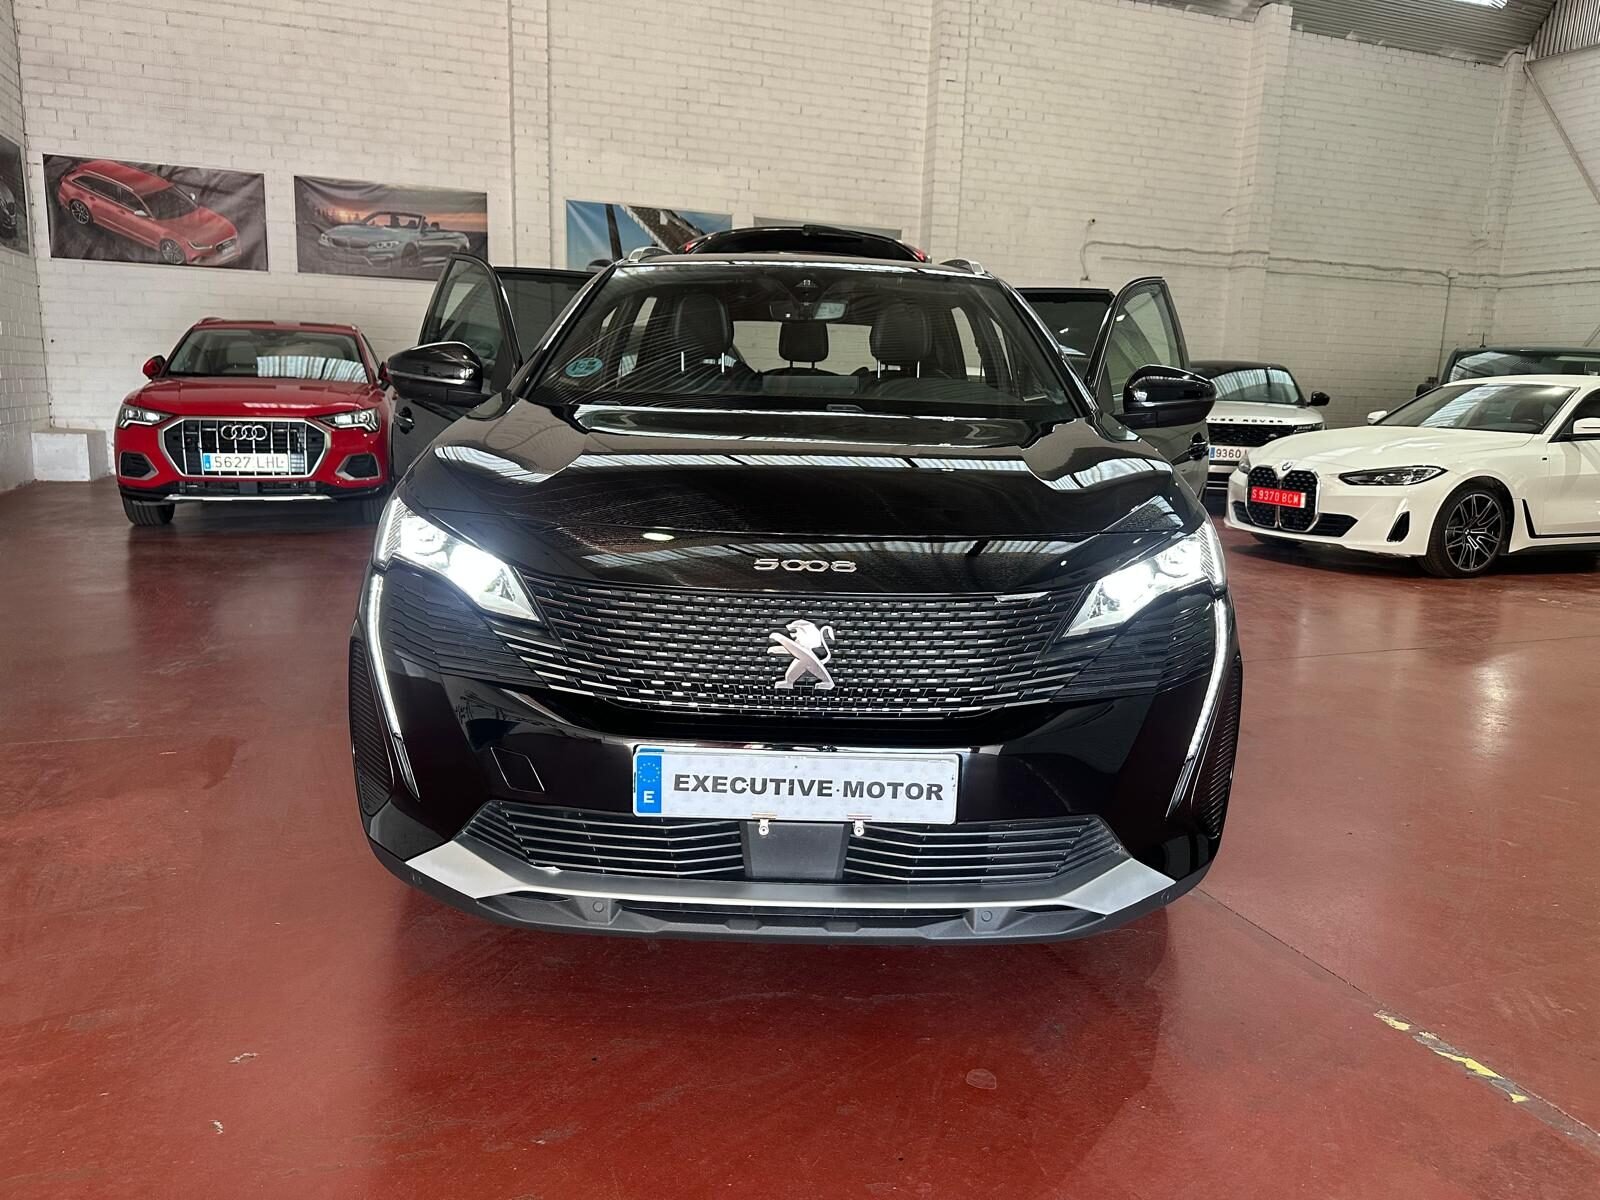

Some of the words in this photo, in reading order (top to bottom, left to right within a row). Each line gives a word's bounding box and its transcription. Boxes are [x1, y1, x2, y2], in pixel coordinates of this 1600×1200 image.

[1215, 448, 1242, 458] 9360
[214, 455, 251, 469] 5627
[256, 456, 285, 469] LHL
[1251, 488, 1258, 499] S
[1258, 489, 1280, 502] 9370
[753, 558, 857, 573] 5008
[643, 790, 655, 804] E
[673, 773, 833, 797] EXECUTIVE
[843, 779, 944, 801] MOTOR
